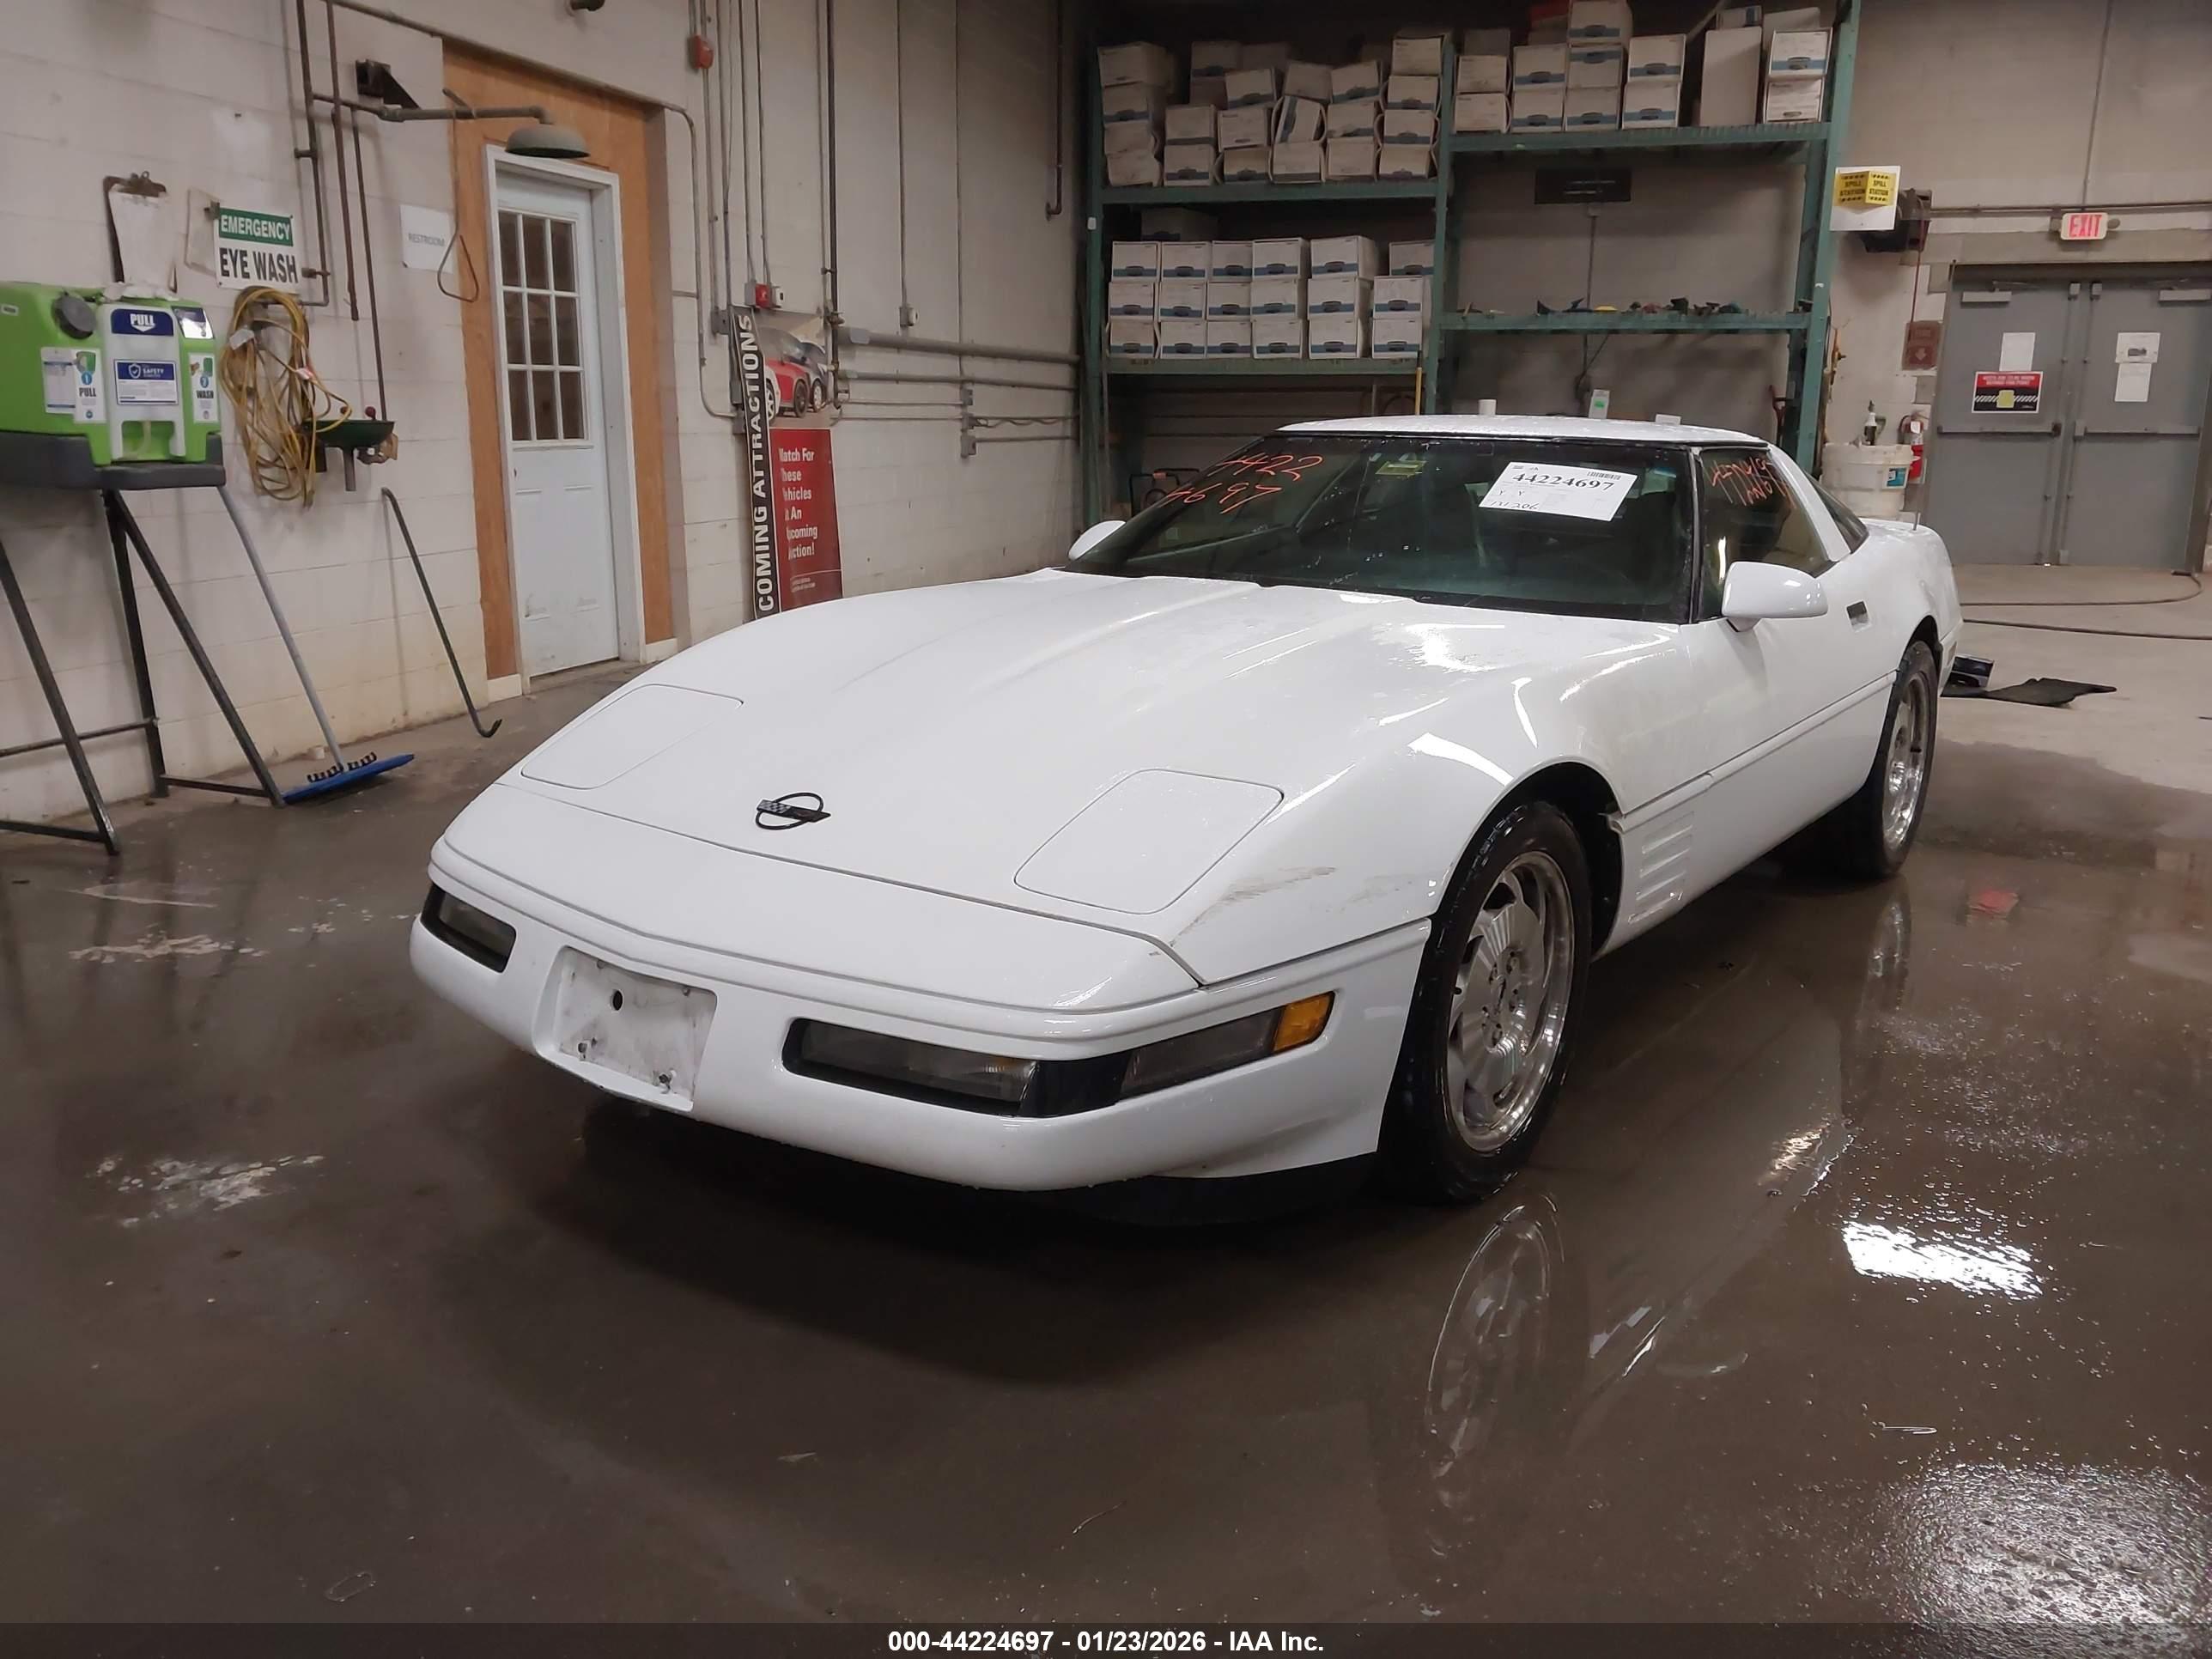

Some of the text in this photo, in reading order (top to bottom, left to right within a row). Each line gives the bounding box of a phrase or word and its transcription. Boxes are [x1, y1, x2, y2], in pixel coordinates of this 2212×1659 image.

[220, 214, 290, 240] EMERGENCY
[2069, 214, 2103, 237] EXIT
[408, 233, 445, 246] RESTROOM
[219, 246, 299, 284] EYE WASH
[130, 313, 155, 326] PULL
[79, 387, 97, 398] PULL
[197, 390, 214, 399] WASH
[802, 447, 815, 461] For
[738, 315, 775, 612] COMING ATTRACTIONS
[1512, 472, 1615, 491] 44224697
[790, 506, 802, 520] An
